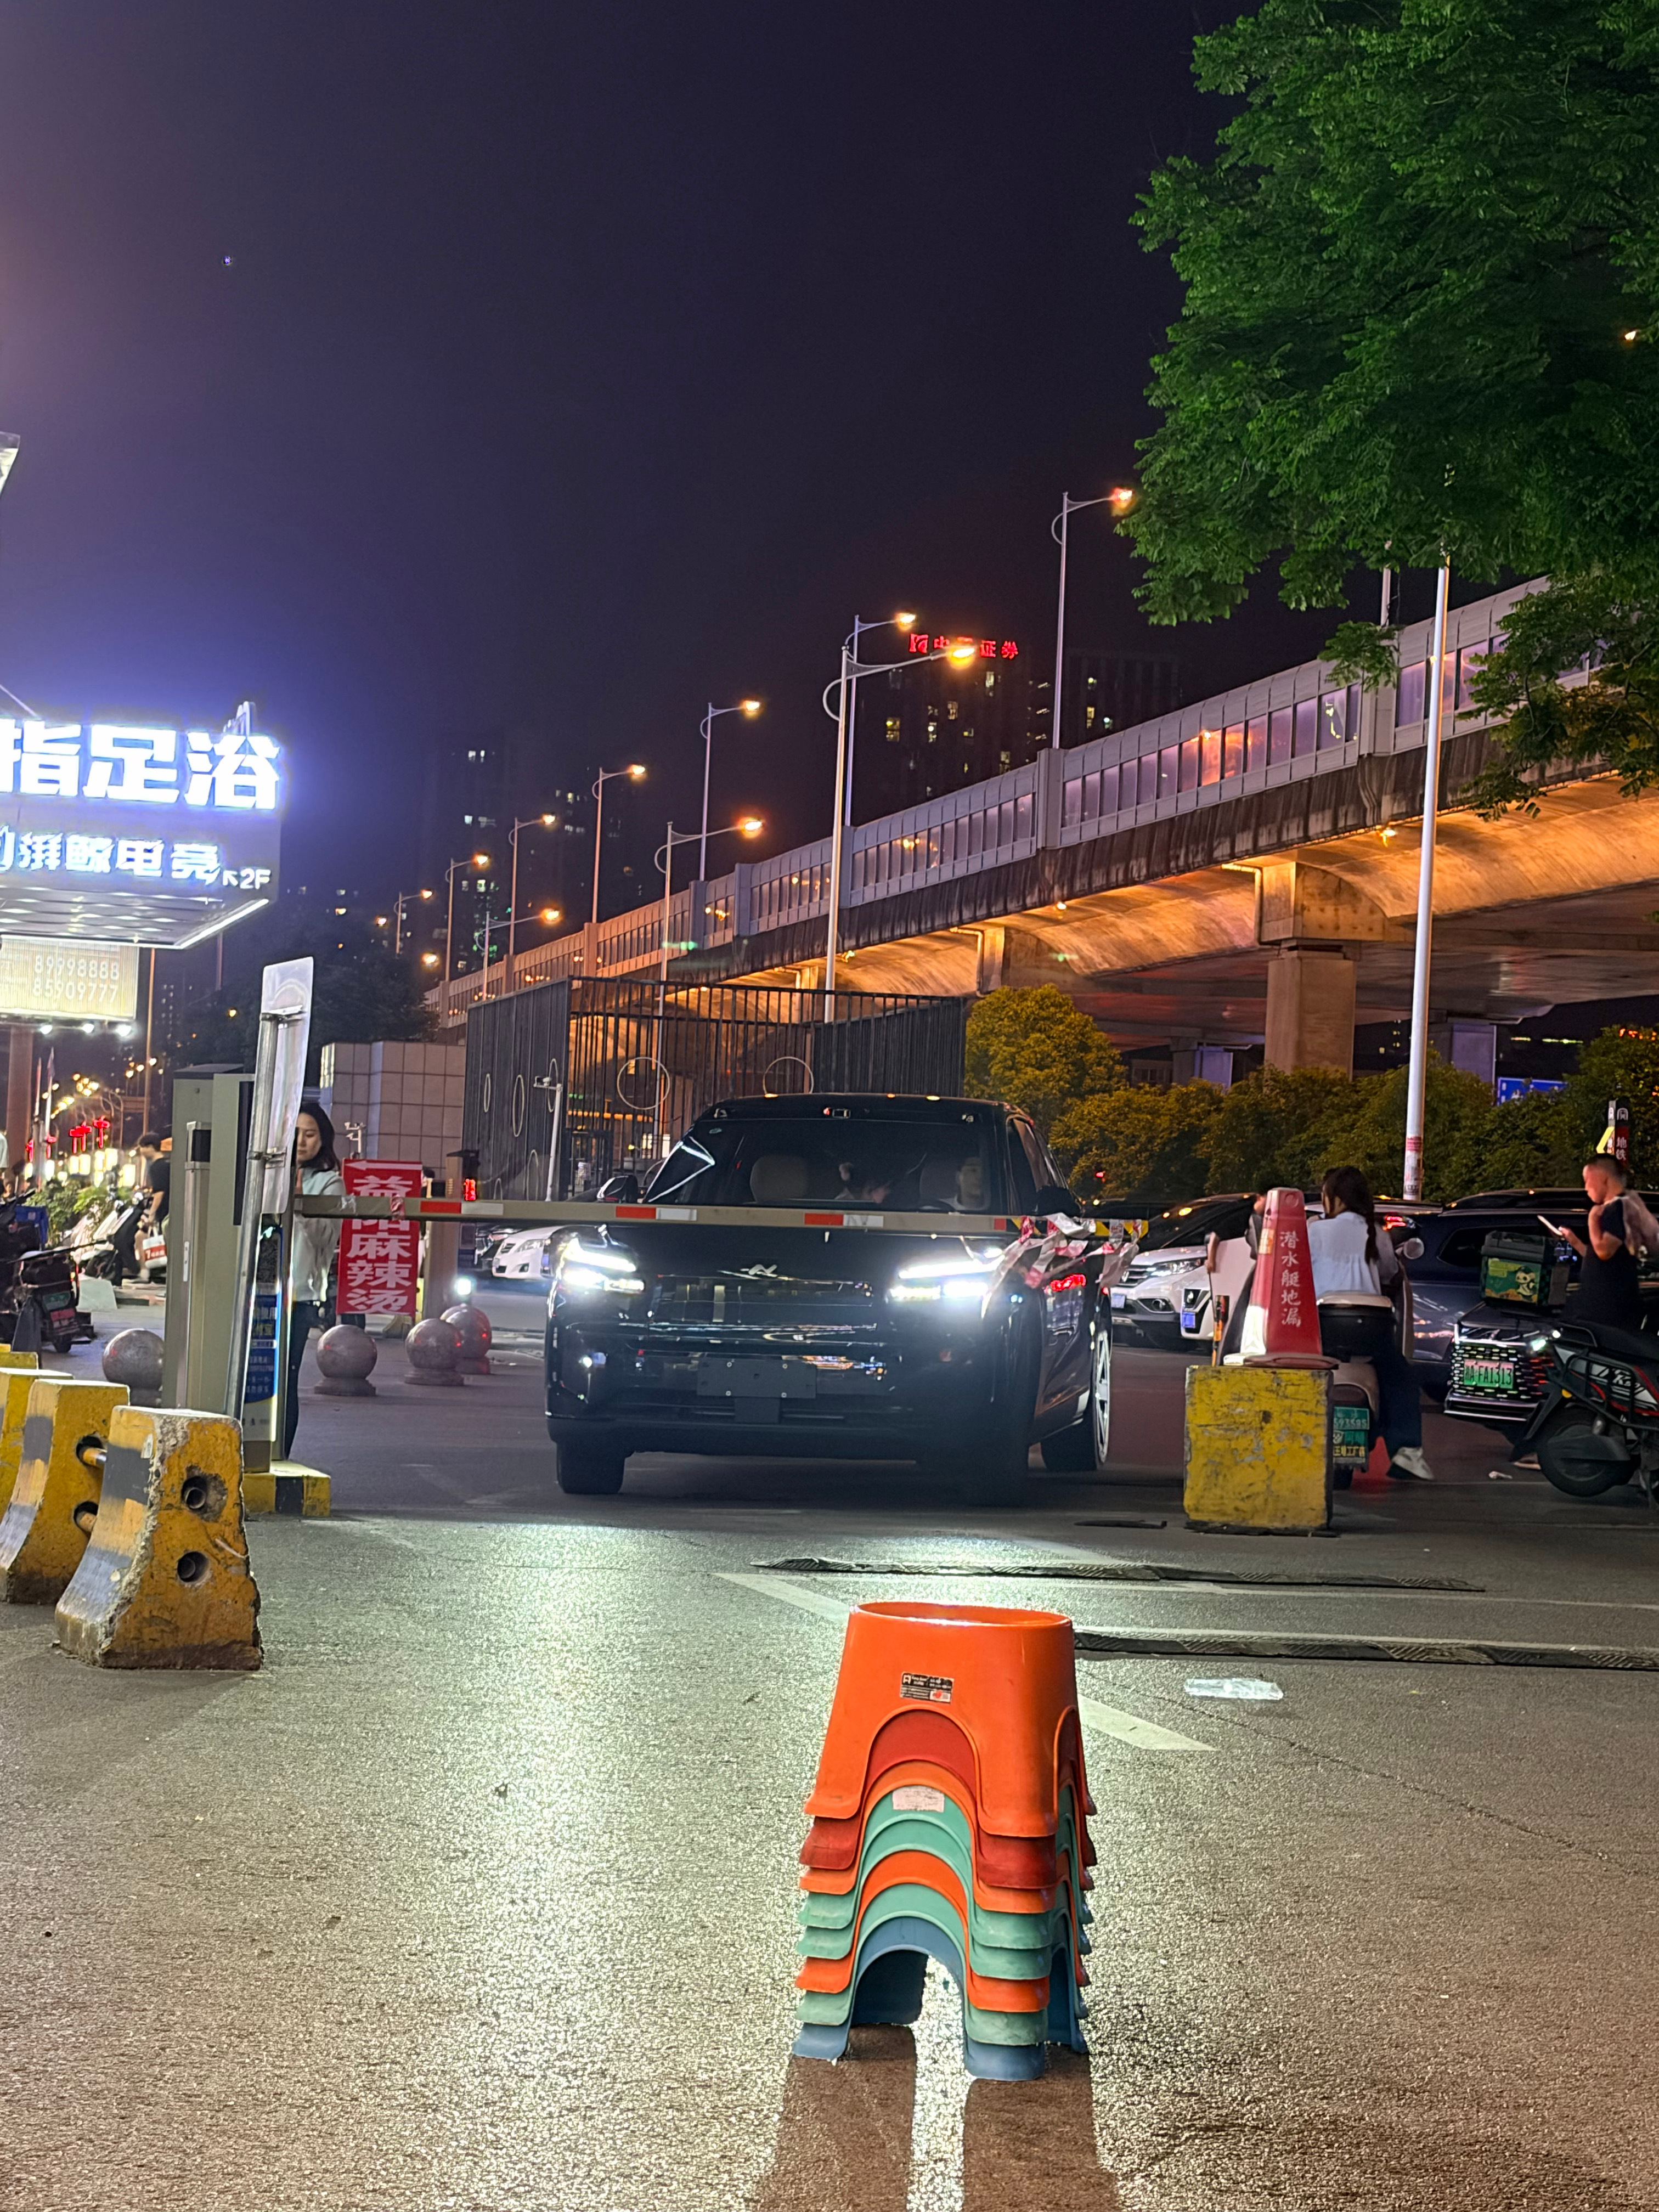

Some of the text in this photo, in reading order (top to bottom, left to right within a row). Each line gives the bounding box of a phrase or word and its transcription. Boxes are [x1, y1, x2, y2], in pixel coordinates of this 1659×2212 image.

[934, 635, 1018, 659] 中证券
[239, 868, 271, 889] 2F
[34, 955, 120, 981] 89998888
[1616, 1136, 1627, 1161] 地铁
[1279, 1230, 1302, 1333] 潜水艇地漏
